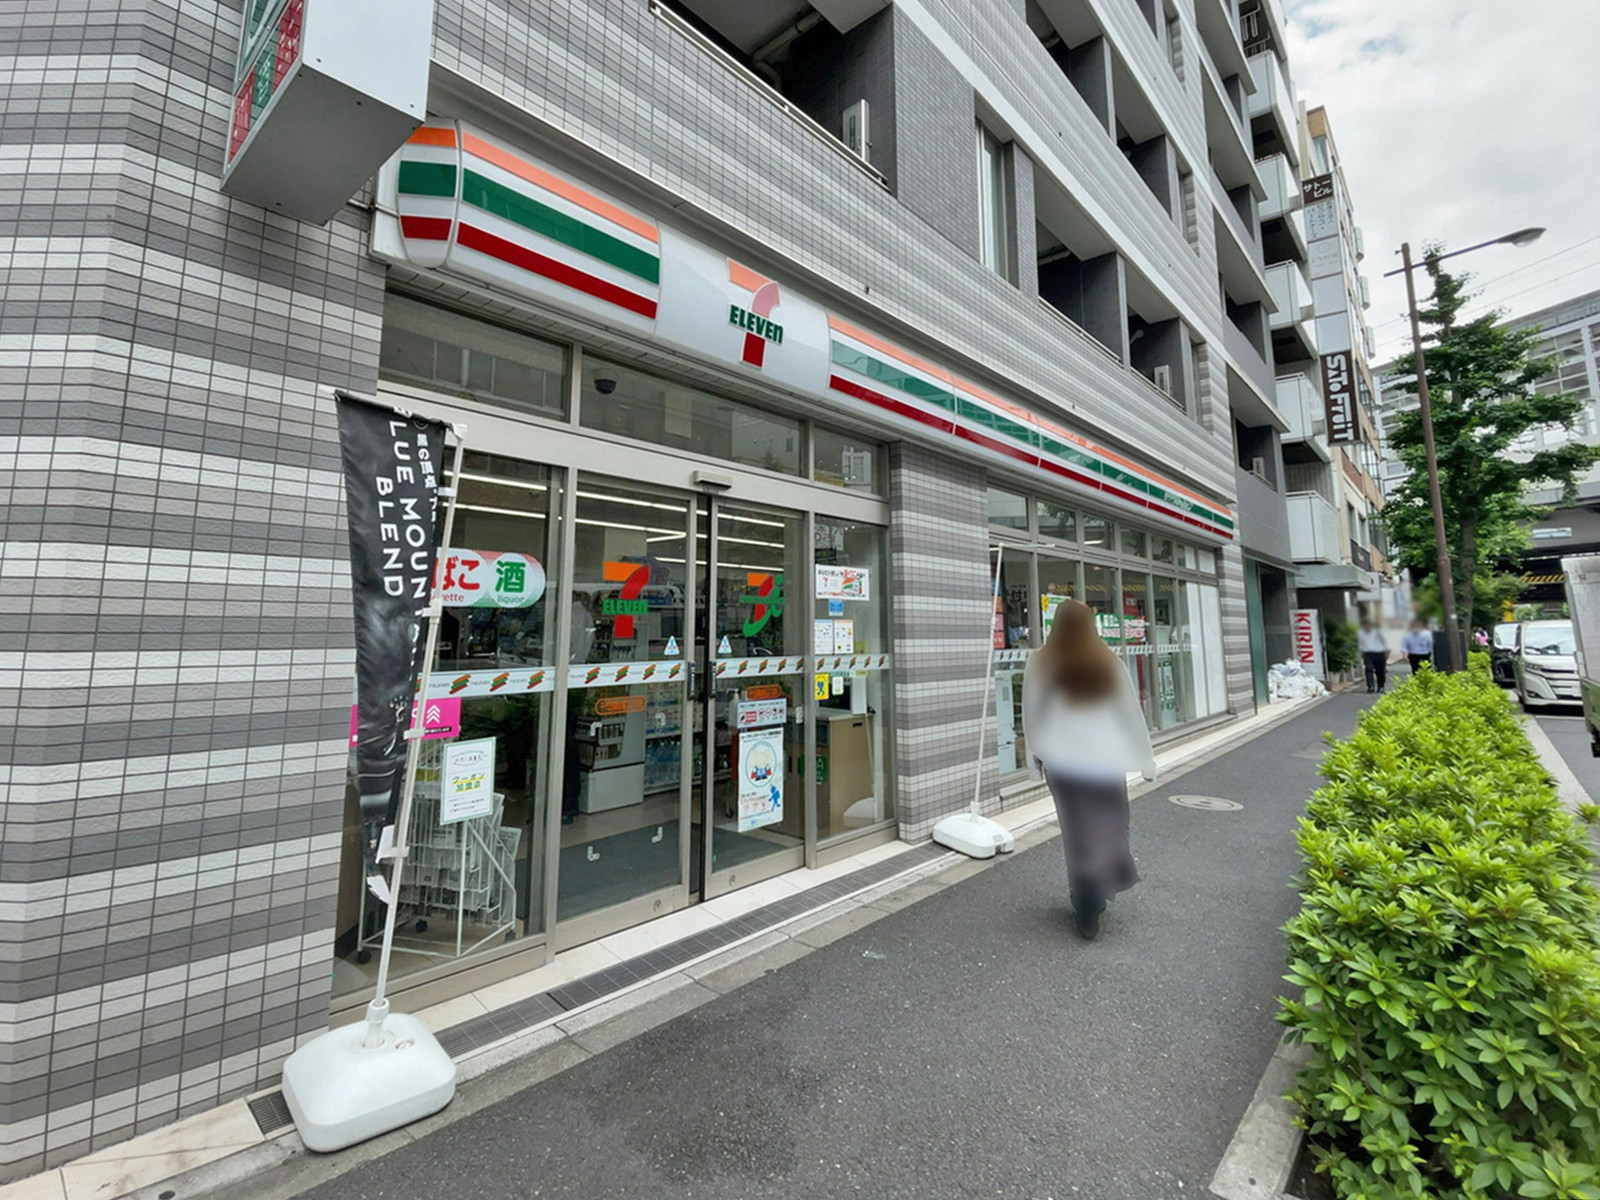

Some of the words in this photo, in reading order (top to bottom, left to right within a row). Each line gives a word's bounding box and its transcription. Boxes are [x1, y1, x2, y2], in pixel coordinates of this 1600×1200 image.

[1303, 180, 1331, 193] サトー
[1313, 187, 1332, 198] ビル
[376, 477, 403, 596] BLEND
[495, 560, 526, 593] 酒
[497, 594, 526, 605] liquor
[1293, 613, 1315, 663] KIRIN
